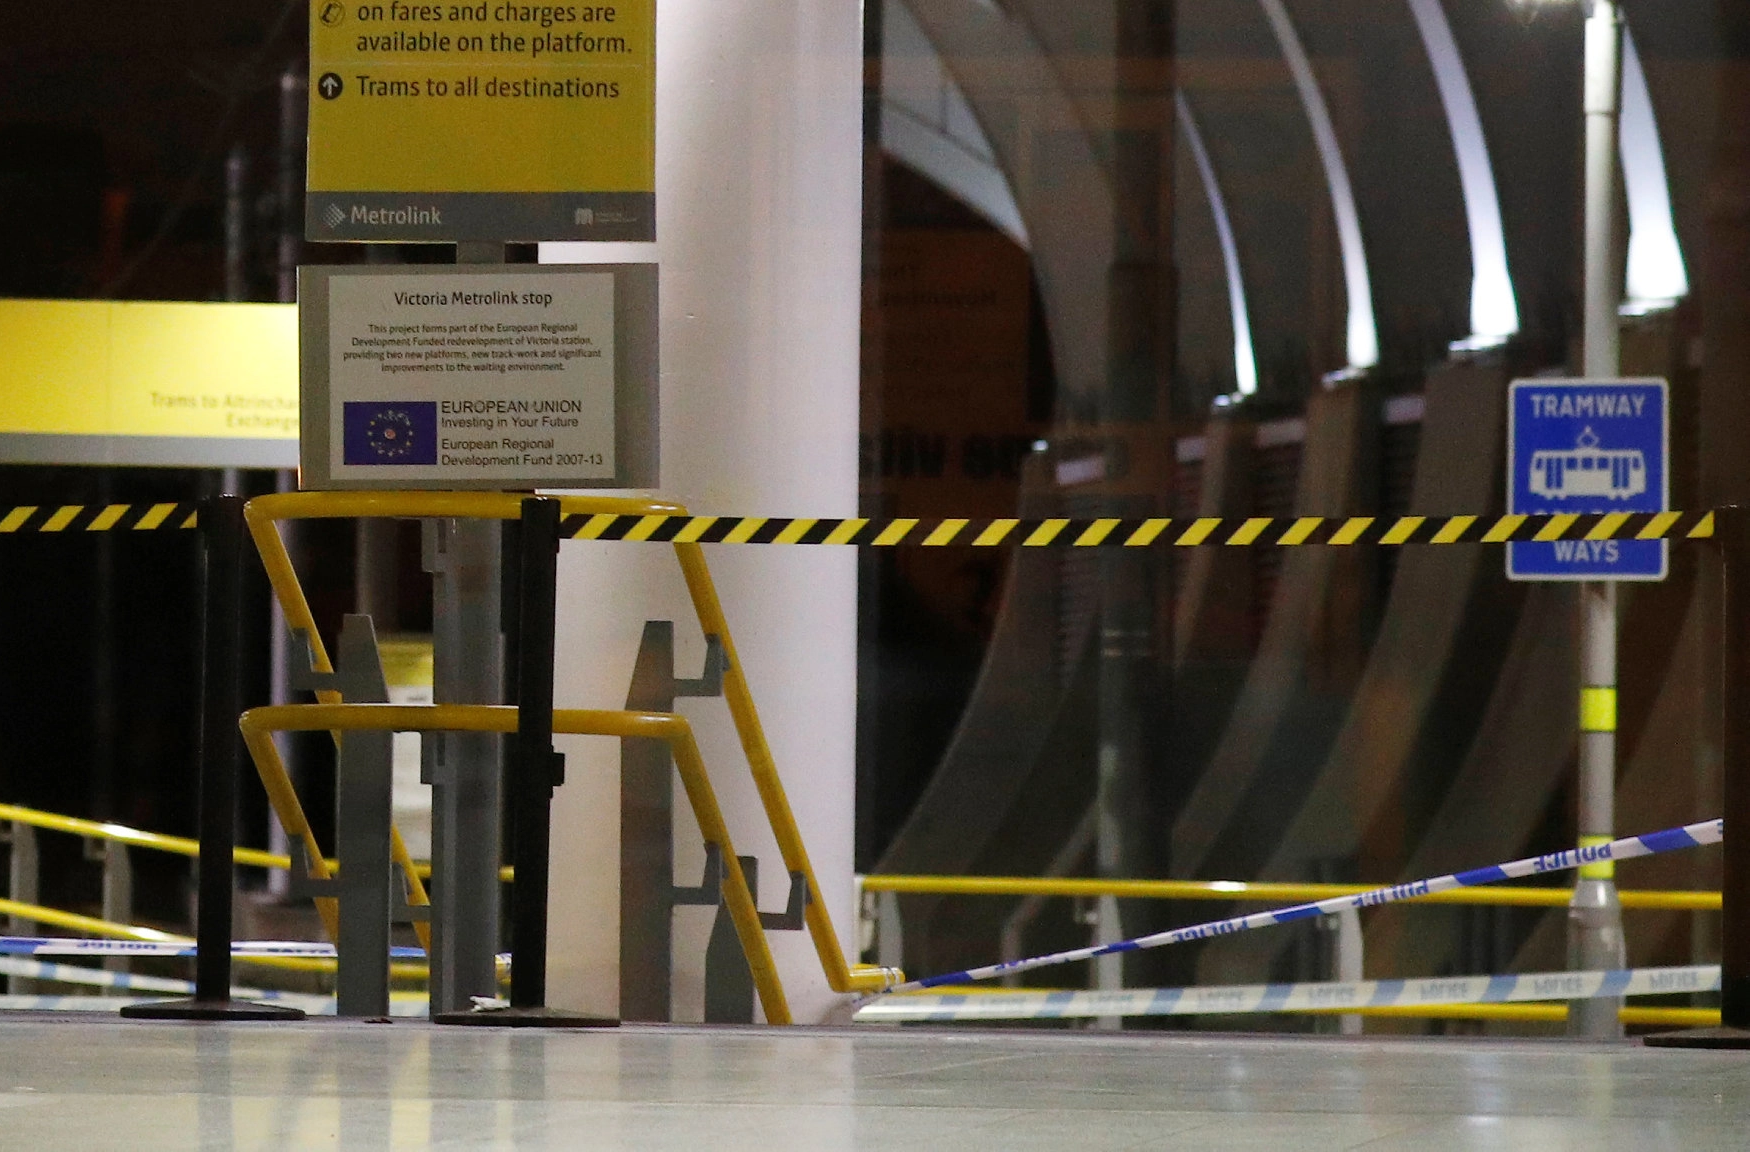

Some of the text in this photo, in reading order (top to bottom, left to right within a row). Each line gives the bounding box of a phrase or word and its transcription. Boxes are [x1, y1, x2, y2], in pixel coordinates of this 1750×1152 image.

[357, 1, 616, 27] on fares and charges are
[356, 31, 633, 58] available on the platform.
[356, 75, 620, 98] Trams to all destinations
[350, 205, 441, 226] Metrolink
[394, 291, 553, 308] Victoria Metrolink stop
[368, 323, 577, 335] This project forms part of the European Regional
[352, 337, 411, 347] Development
[413, 337, 445, 346] Funded
[447, 337, 513, 347] redevelopment
[515, 336, 526, 345] of
[527, 336, 559, 345] Victoria
[343, 351, 385, 361] providing
[387, 351, 402, 359] two
[405, 351, 422, 359] new
[471, 351, 489, 359] new
[540, 349, 556, 358] and
[558, 349, 601, 360] significant
[457, 363, 471, 371] the
[473, 364, 506, 374] waiting
[441, 399, 583, 414] EUROPEAN UNION
[1530, 393, 1646, 418] TRAMWAY
[441, 416, 579, 430] Investing in Your Future
[441, 438, 555, 451] European Regional
[441, 454, 603, 468] Development Fund 2007-13
[1554, 539, 1619, 564] WAYS
